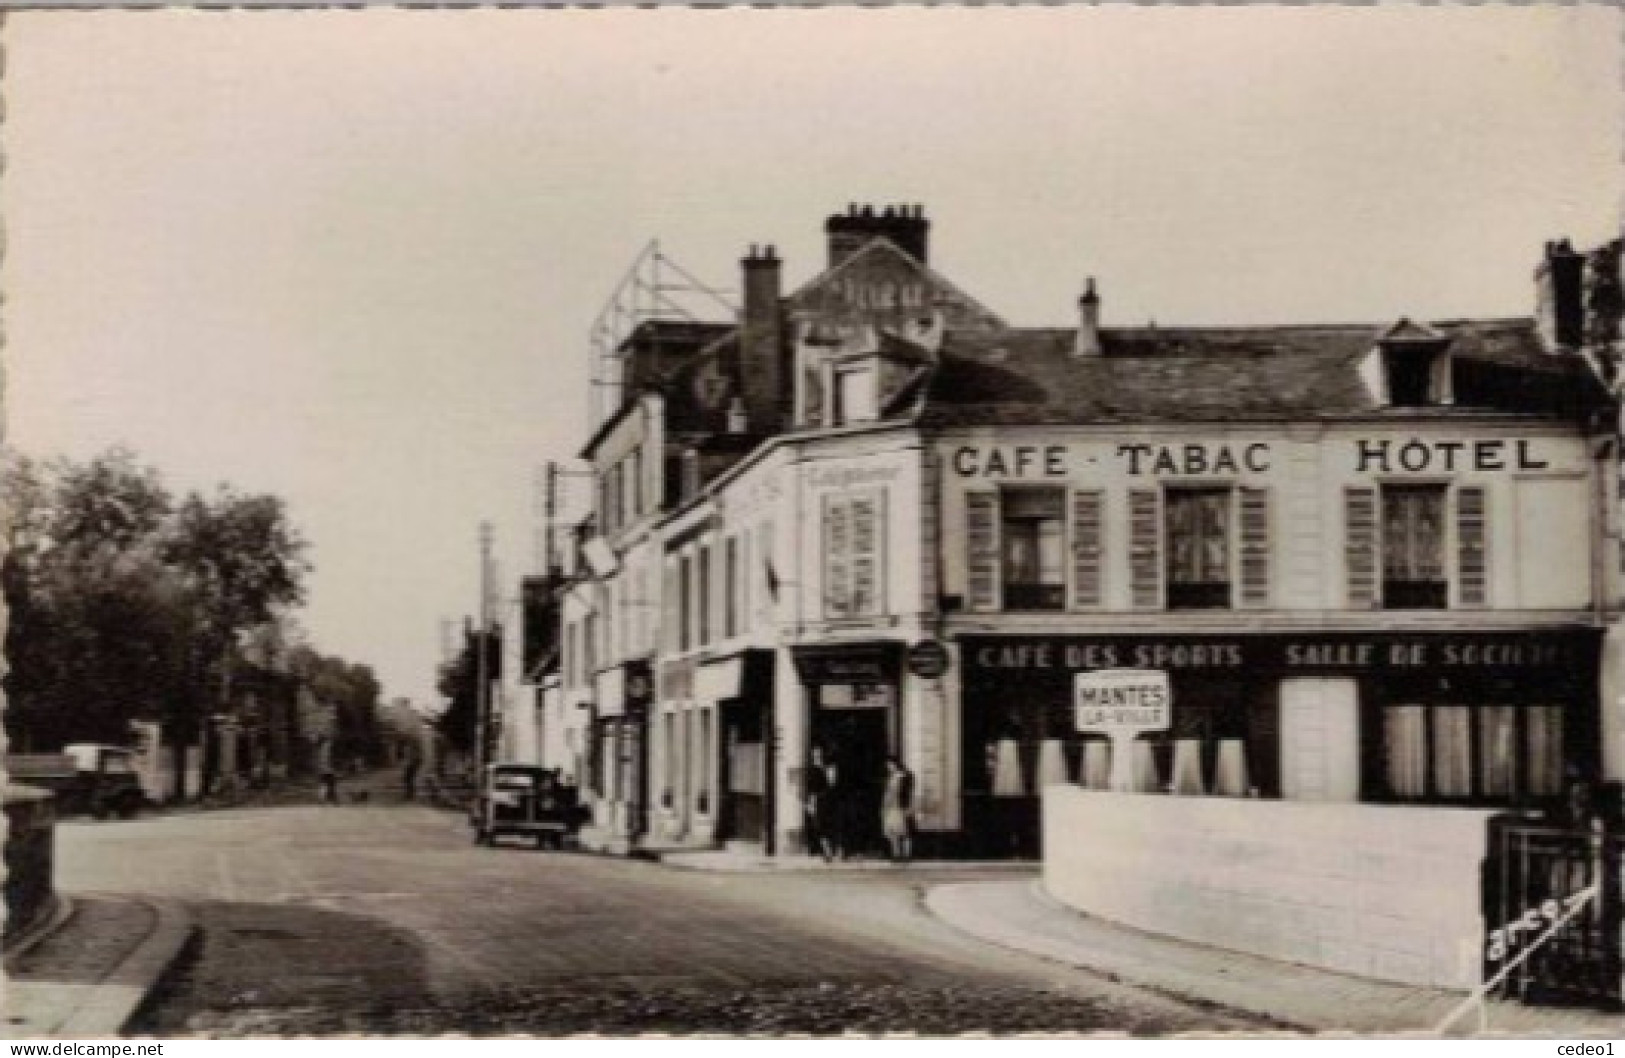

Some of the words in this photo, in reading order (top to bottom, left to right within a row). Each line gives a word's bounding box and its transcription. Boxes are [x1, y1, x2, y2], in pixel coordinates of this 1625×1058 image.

[1115, 443, 1271, 475] TABAC
[1065, 645, 1117, 667] DES
[1135, 645, 1243, 667] SPORTS
[1286, 645, 1374, 665] SALLE
[1390, 645, 1426, 665] DE
[1081, 685, 1163, 706] MANTES
